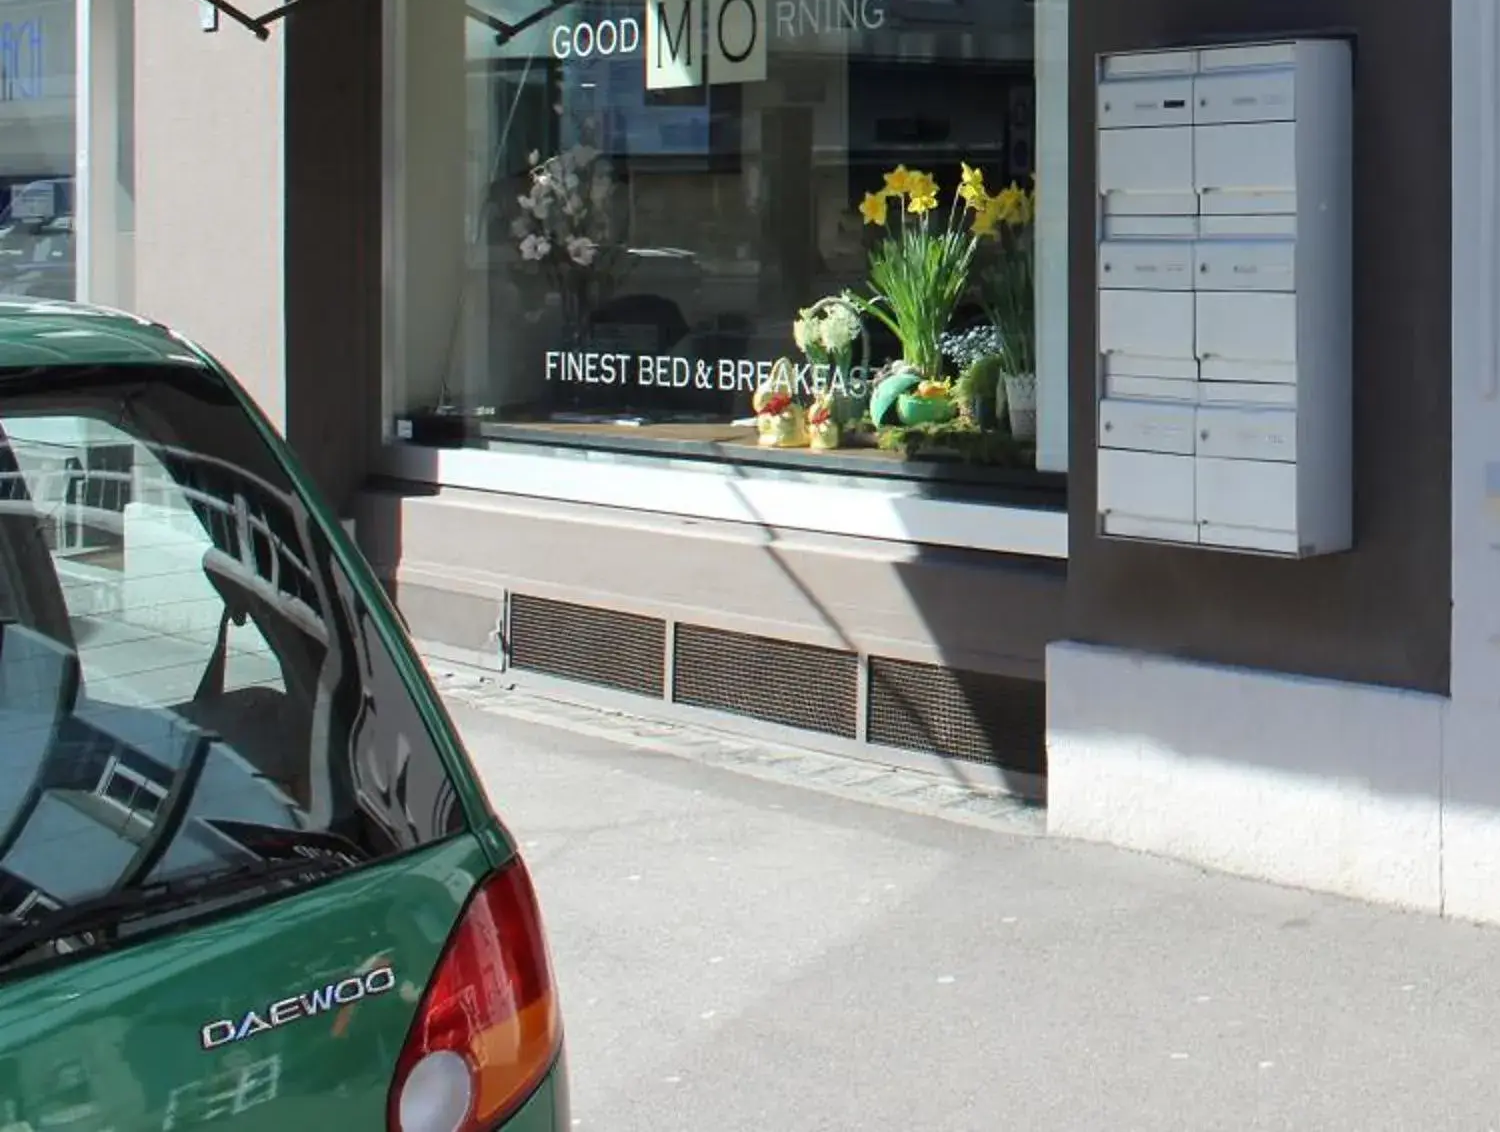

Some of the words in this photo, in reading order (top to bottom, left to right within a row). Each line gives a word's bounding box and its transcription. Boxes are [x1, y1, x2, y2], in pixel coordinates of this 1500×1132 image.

[552, 18, 639, 60] GOOD
[545, 351, 631, 385] FINEST
[638, 356, 690, 388] BED
[696, 359, 713, 389] &
[202, 967, 395, 1048] DAEWOO
